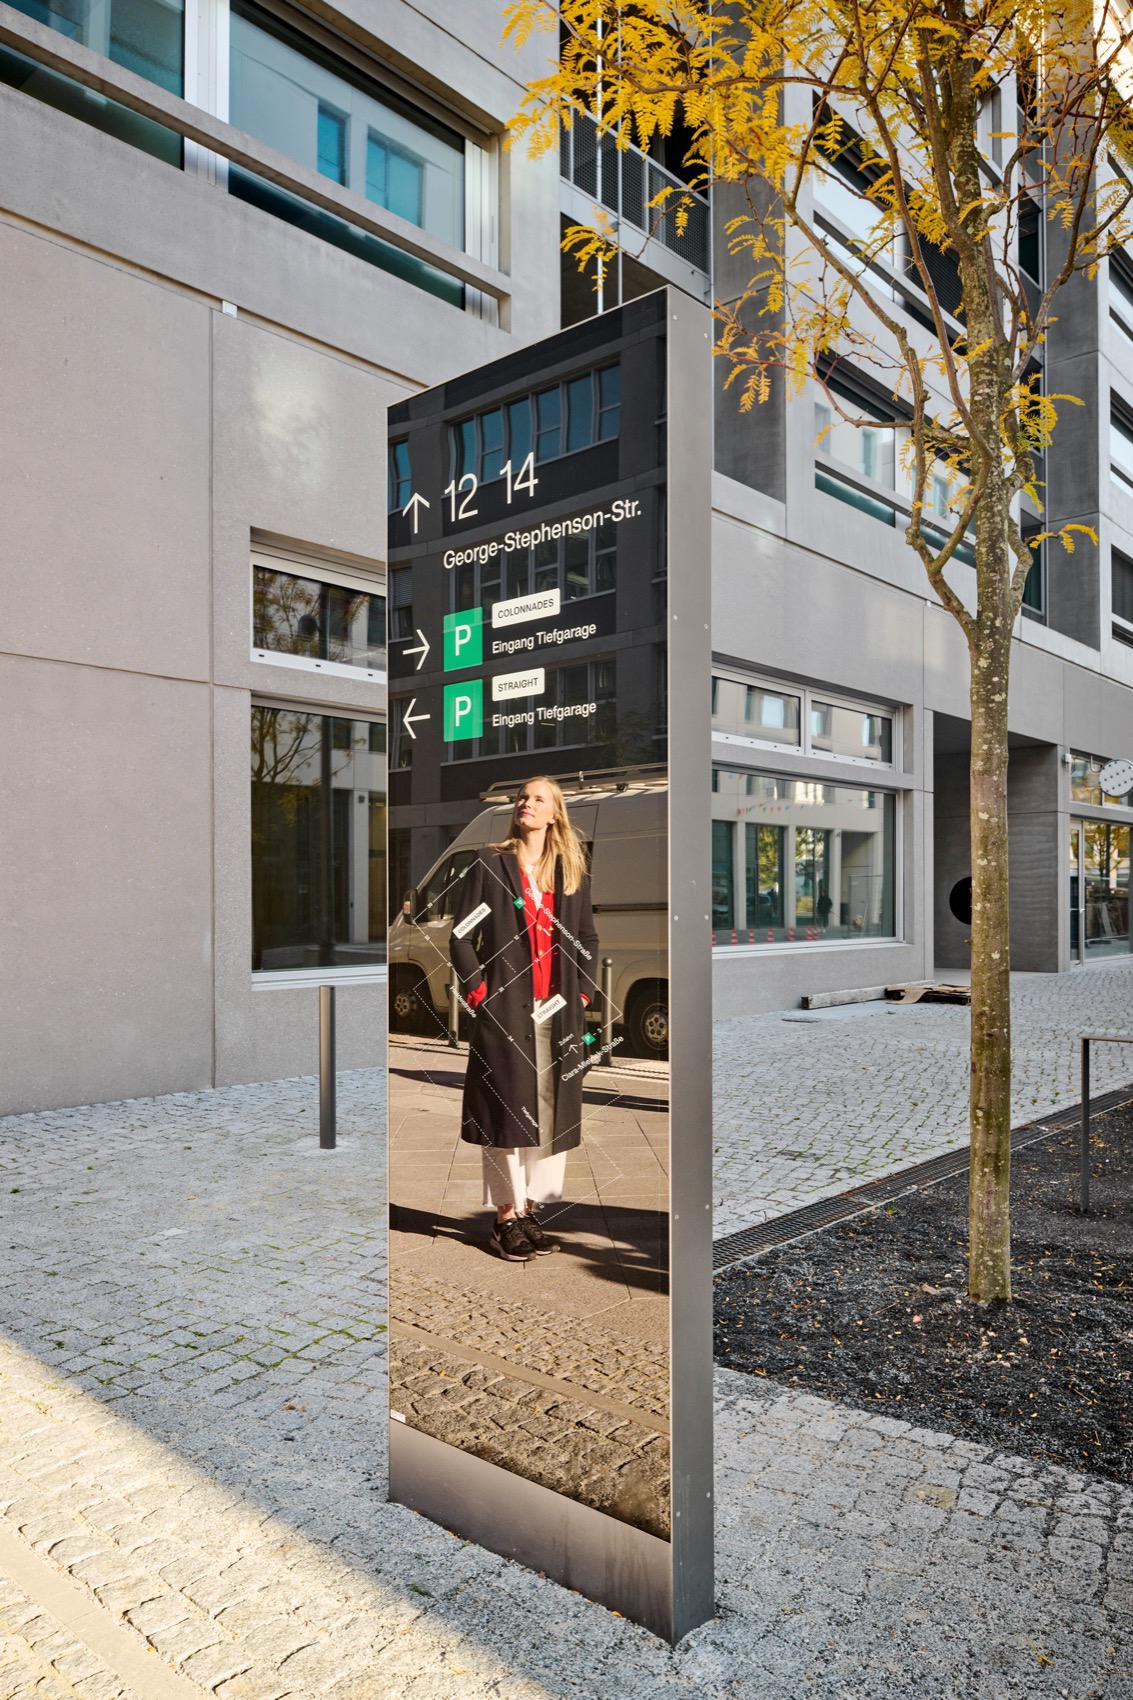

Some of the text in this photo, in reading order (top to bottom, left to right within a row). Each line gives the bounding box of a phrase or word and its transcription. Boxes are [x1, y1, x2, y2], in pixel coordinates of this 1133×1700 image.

[444, 452, 538, 522] 12 14
[443, 499, 642, 570] George-Stephenson-Str.
[497, 598, 555, 619] COLONNADES
[455, 625, 472, 656] P
[492, 623, 597, 654] Eingang Tiefgarage
[497, 677, 539, 693] STRAIGHT
[455, 696, 472, 727] P
[492, 702, 597, 728] Eingang Tiefgarage
[457, 907, 487, 934] COLONNADES
[536, 999, 561, 1020] STRAIGHT
